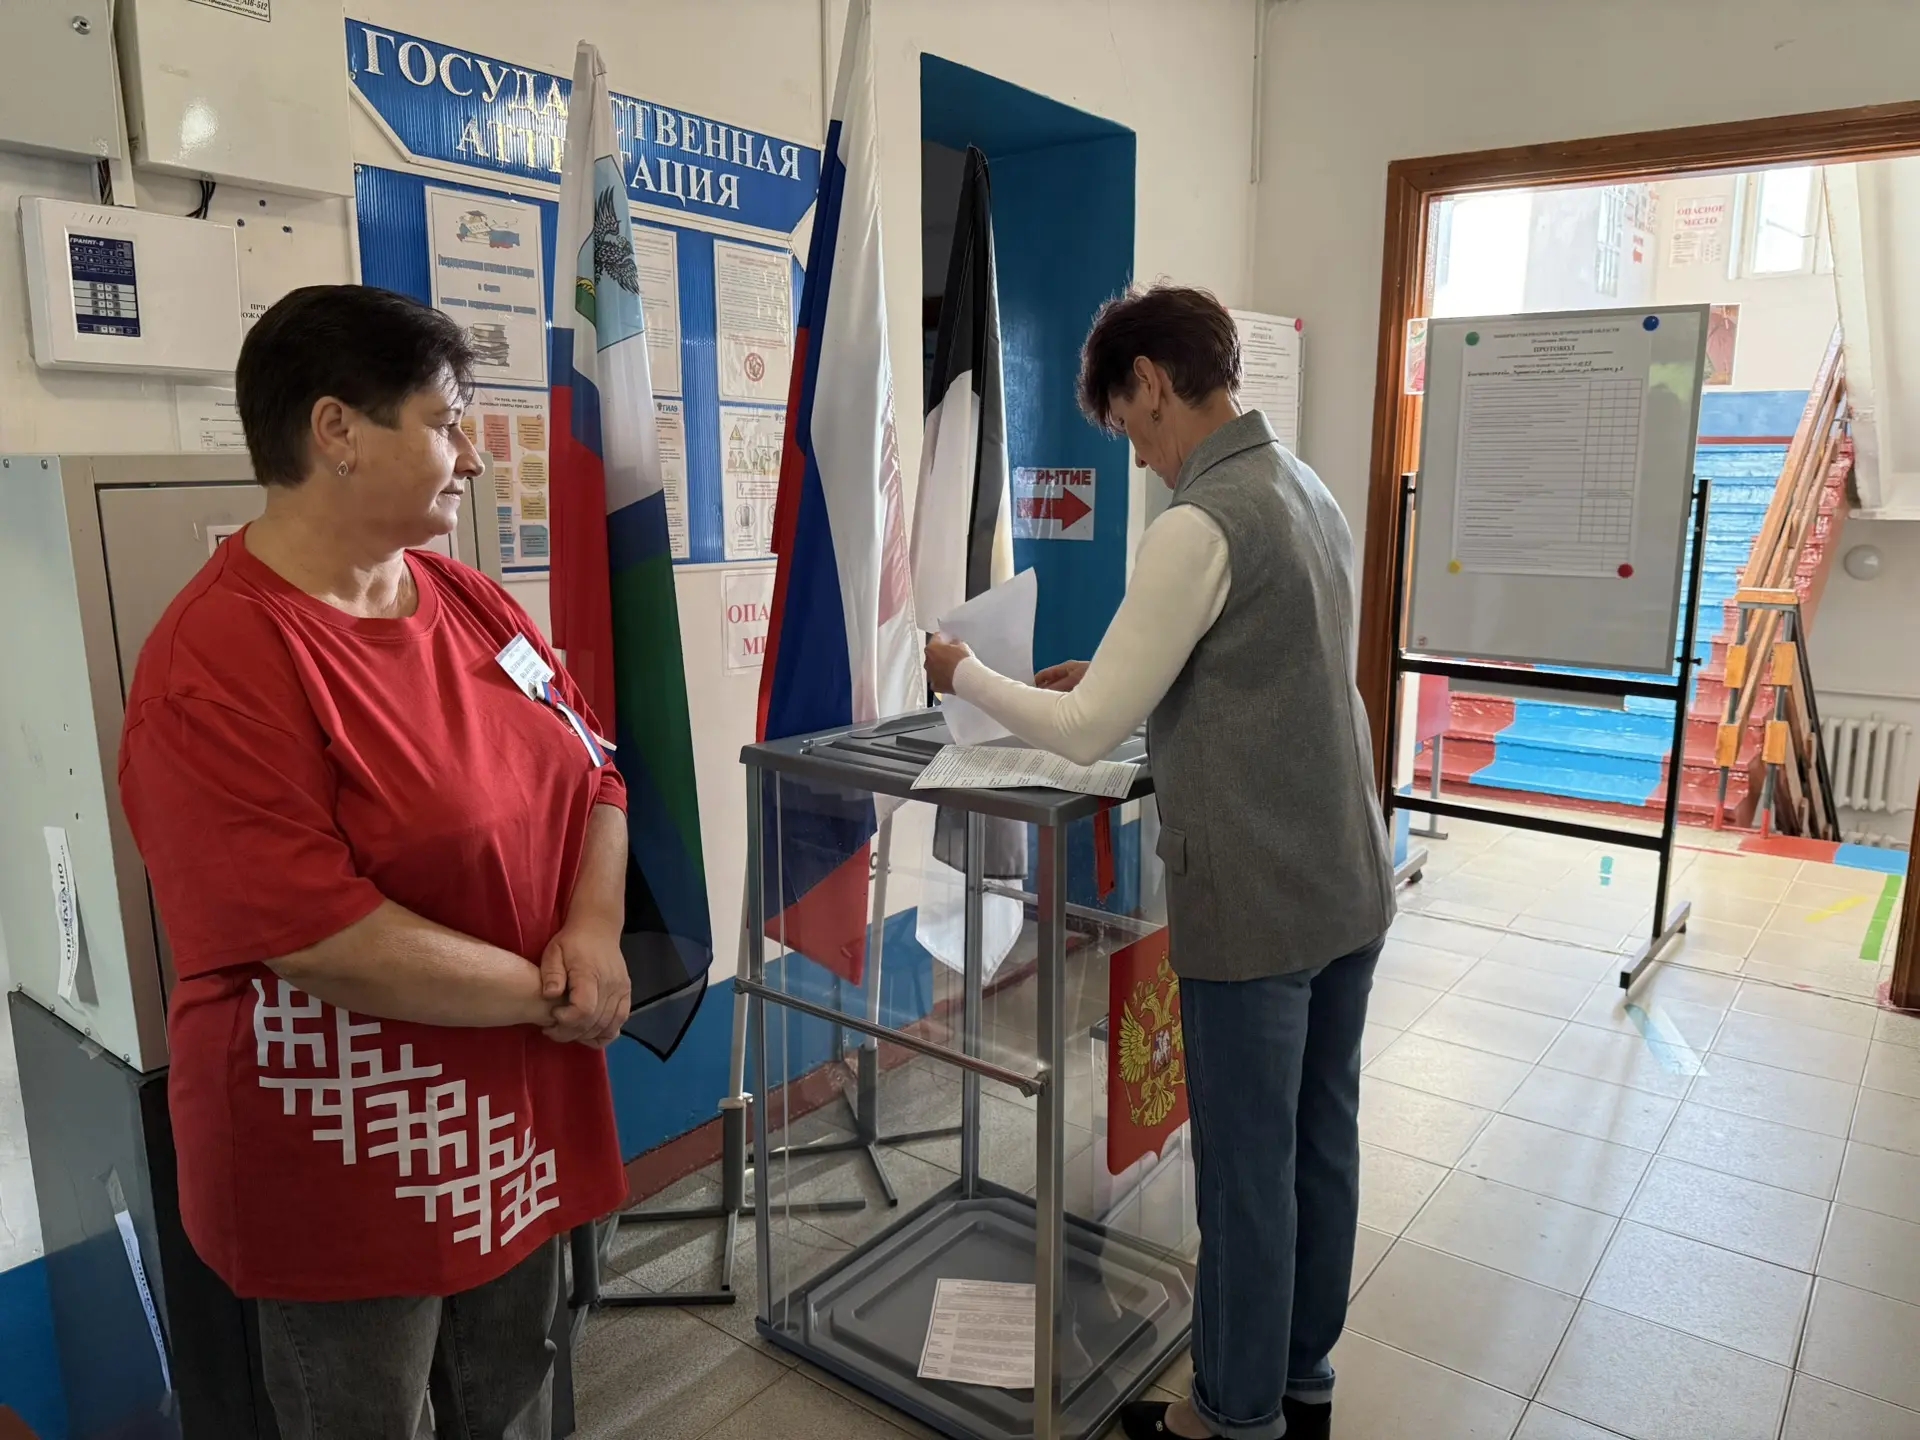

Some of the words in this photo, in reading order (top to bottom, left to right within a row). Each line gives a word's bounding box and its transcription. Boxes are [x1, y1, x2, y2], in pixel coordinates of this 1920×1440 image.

[360, 27, 801, 181] ГОСУДАТВЕННАЯ
[456, 115, 740, 210] АТТЕАЦИЯ
[727, 602, 770, 624] ОПА
